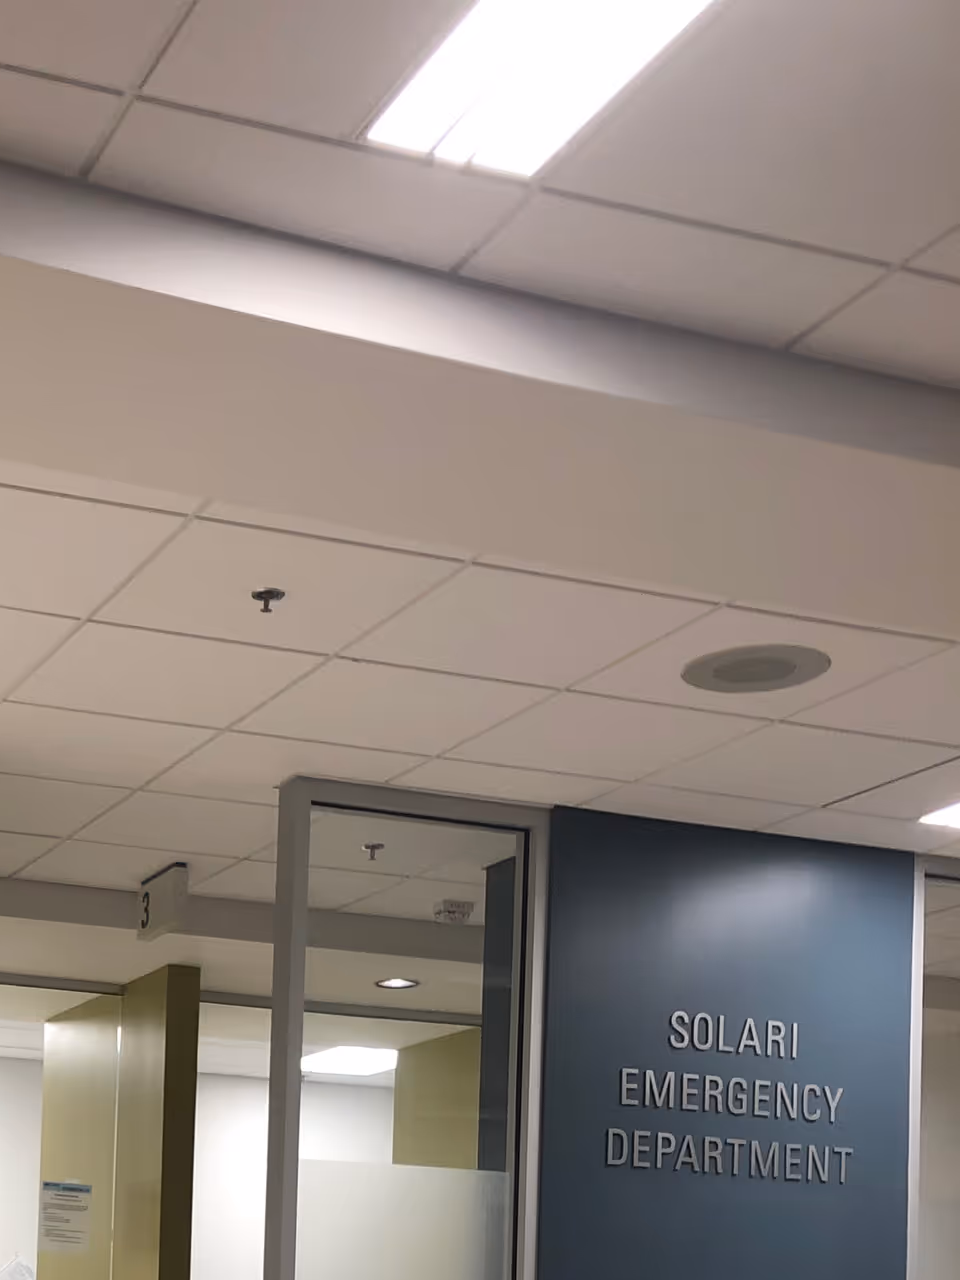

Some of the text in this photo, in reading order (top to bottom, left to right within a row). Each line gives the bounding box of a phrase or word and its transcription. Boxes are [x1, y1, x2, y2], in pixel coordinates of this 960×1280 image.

[141, 891, 150, 930] 3
[669, 1010, 800, 1060] SOLARI
[620, 1067, 844, 1125] EMERGENCY
[606, 1128, 854, 1185] DEPARTMENT
